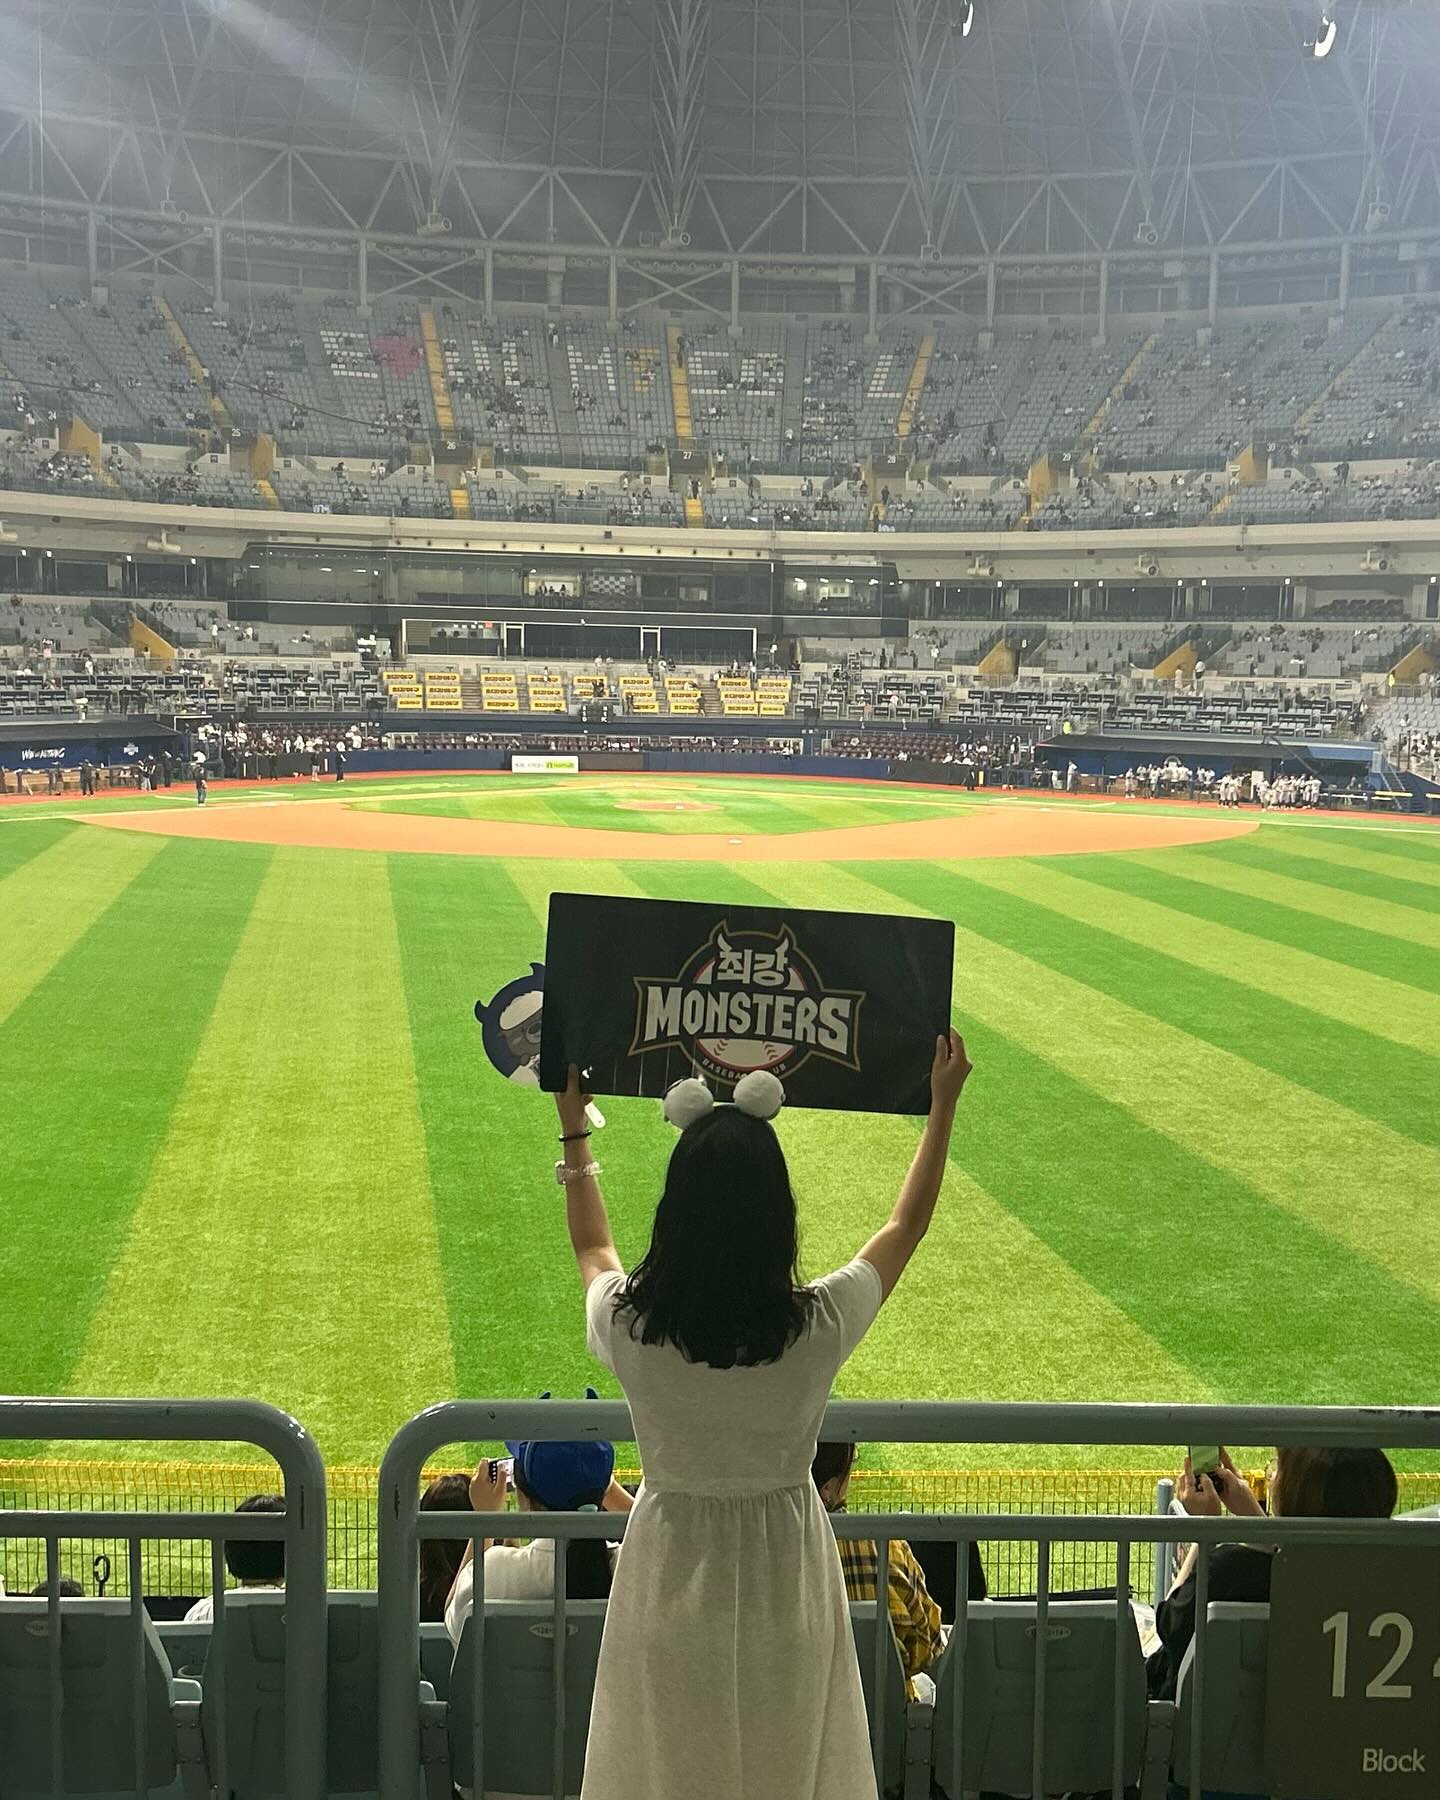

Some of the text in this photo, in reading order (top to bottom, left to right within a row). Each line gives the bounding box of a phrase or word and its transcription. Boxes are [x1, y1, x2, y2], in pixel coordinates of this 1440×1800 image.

[683, 451, 692, 460] 27
[716, 934, 789, 987] 최강
[644, 985, 852, 1055] MONSTERS
[702, 1058, 748, 1080] BASEBA
[1322, 1610, 1440, 1699] 12
[1362, 1748, 1428, 1773] Block
